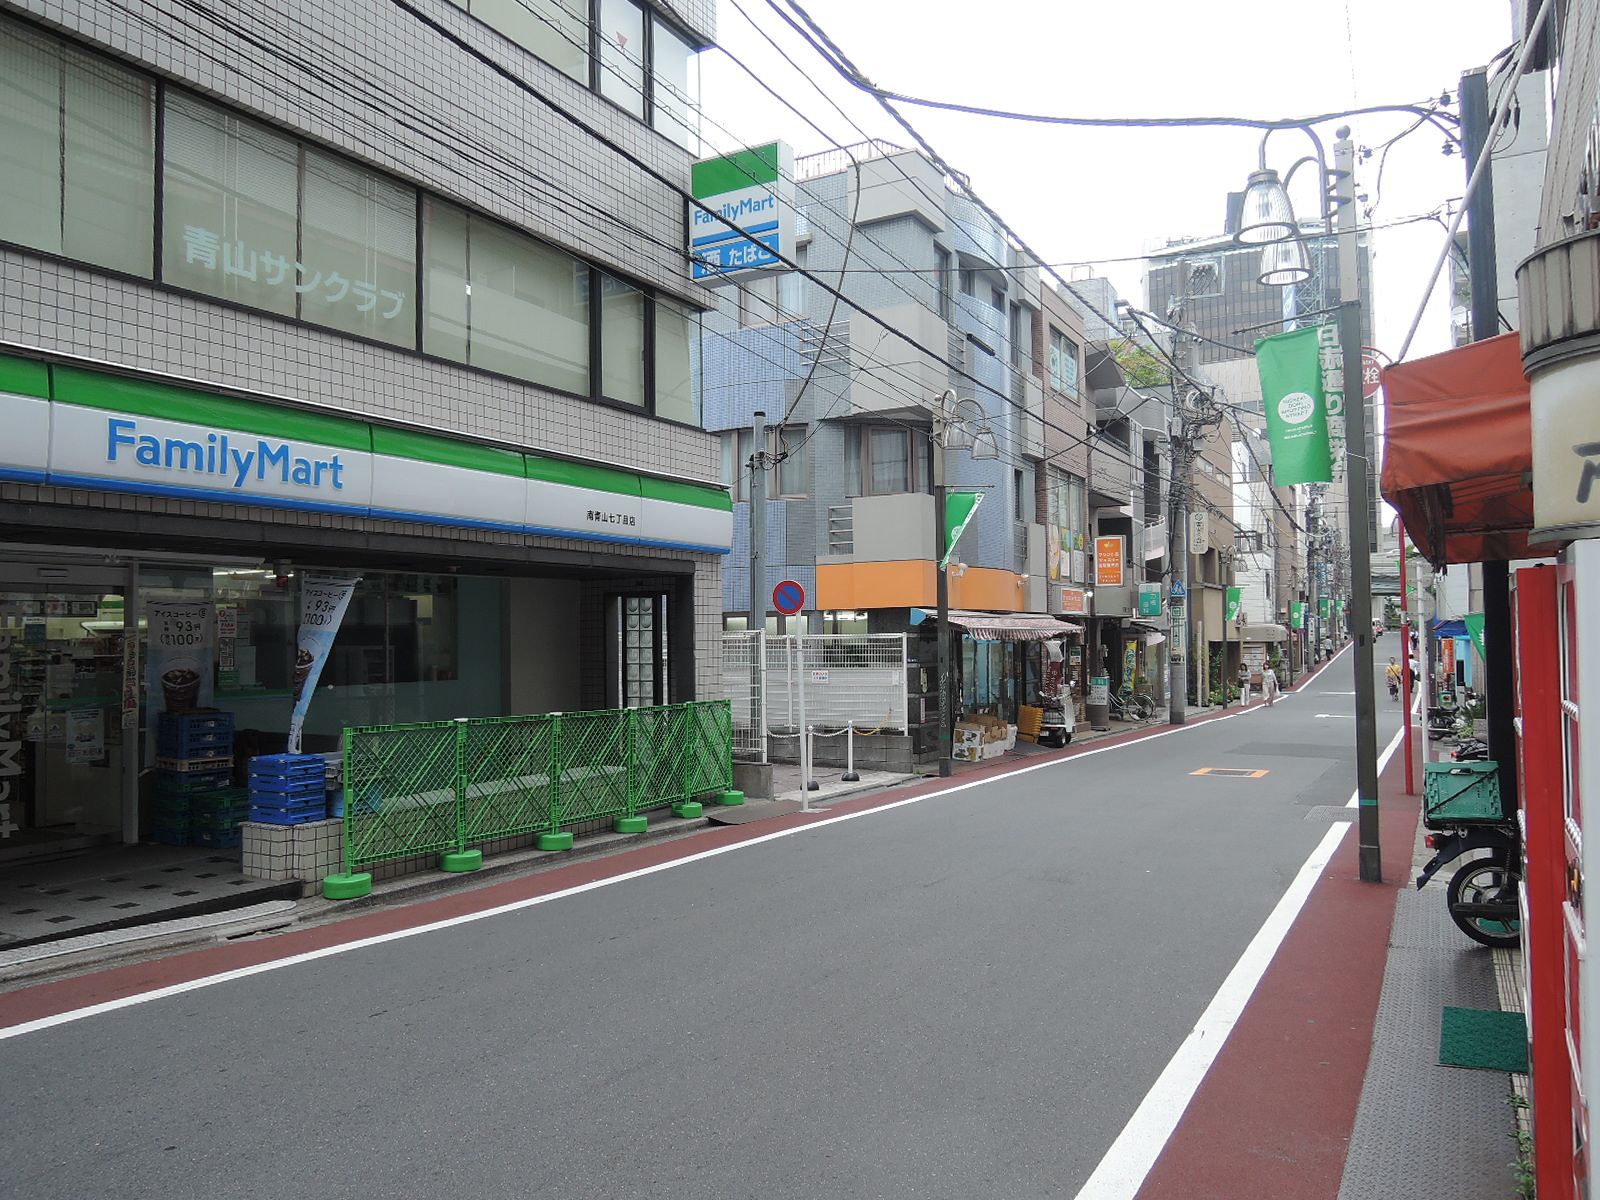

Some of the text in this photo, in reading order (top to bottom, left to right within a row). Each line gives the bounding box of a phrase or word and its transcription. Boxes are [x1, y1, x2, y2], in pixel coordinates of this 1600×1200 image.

[695, 194, 774, 225] FamilyMart
[729, 242, 770, 266] たばこ
[184, 225, 405, 319] 青山サンクラブ
[107, 418, 343, 489] FamilyMart
[586, 510, 636, 526] 南青山七丁目店
[154, 610, 198, 618] アイスコーヒー
